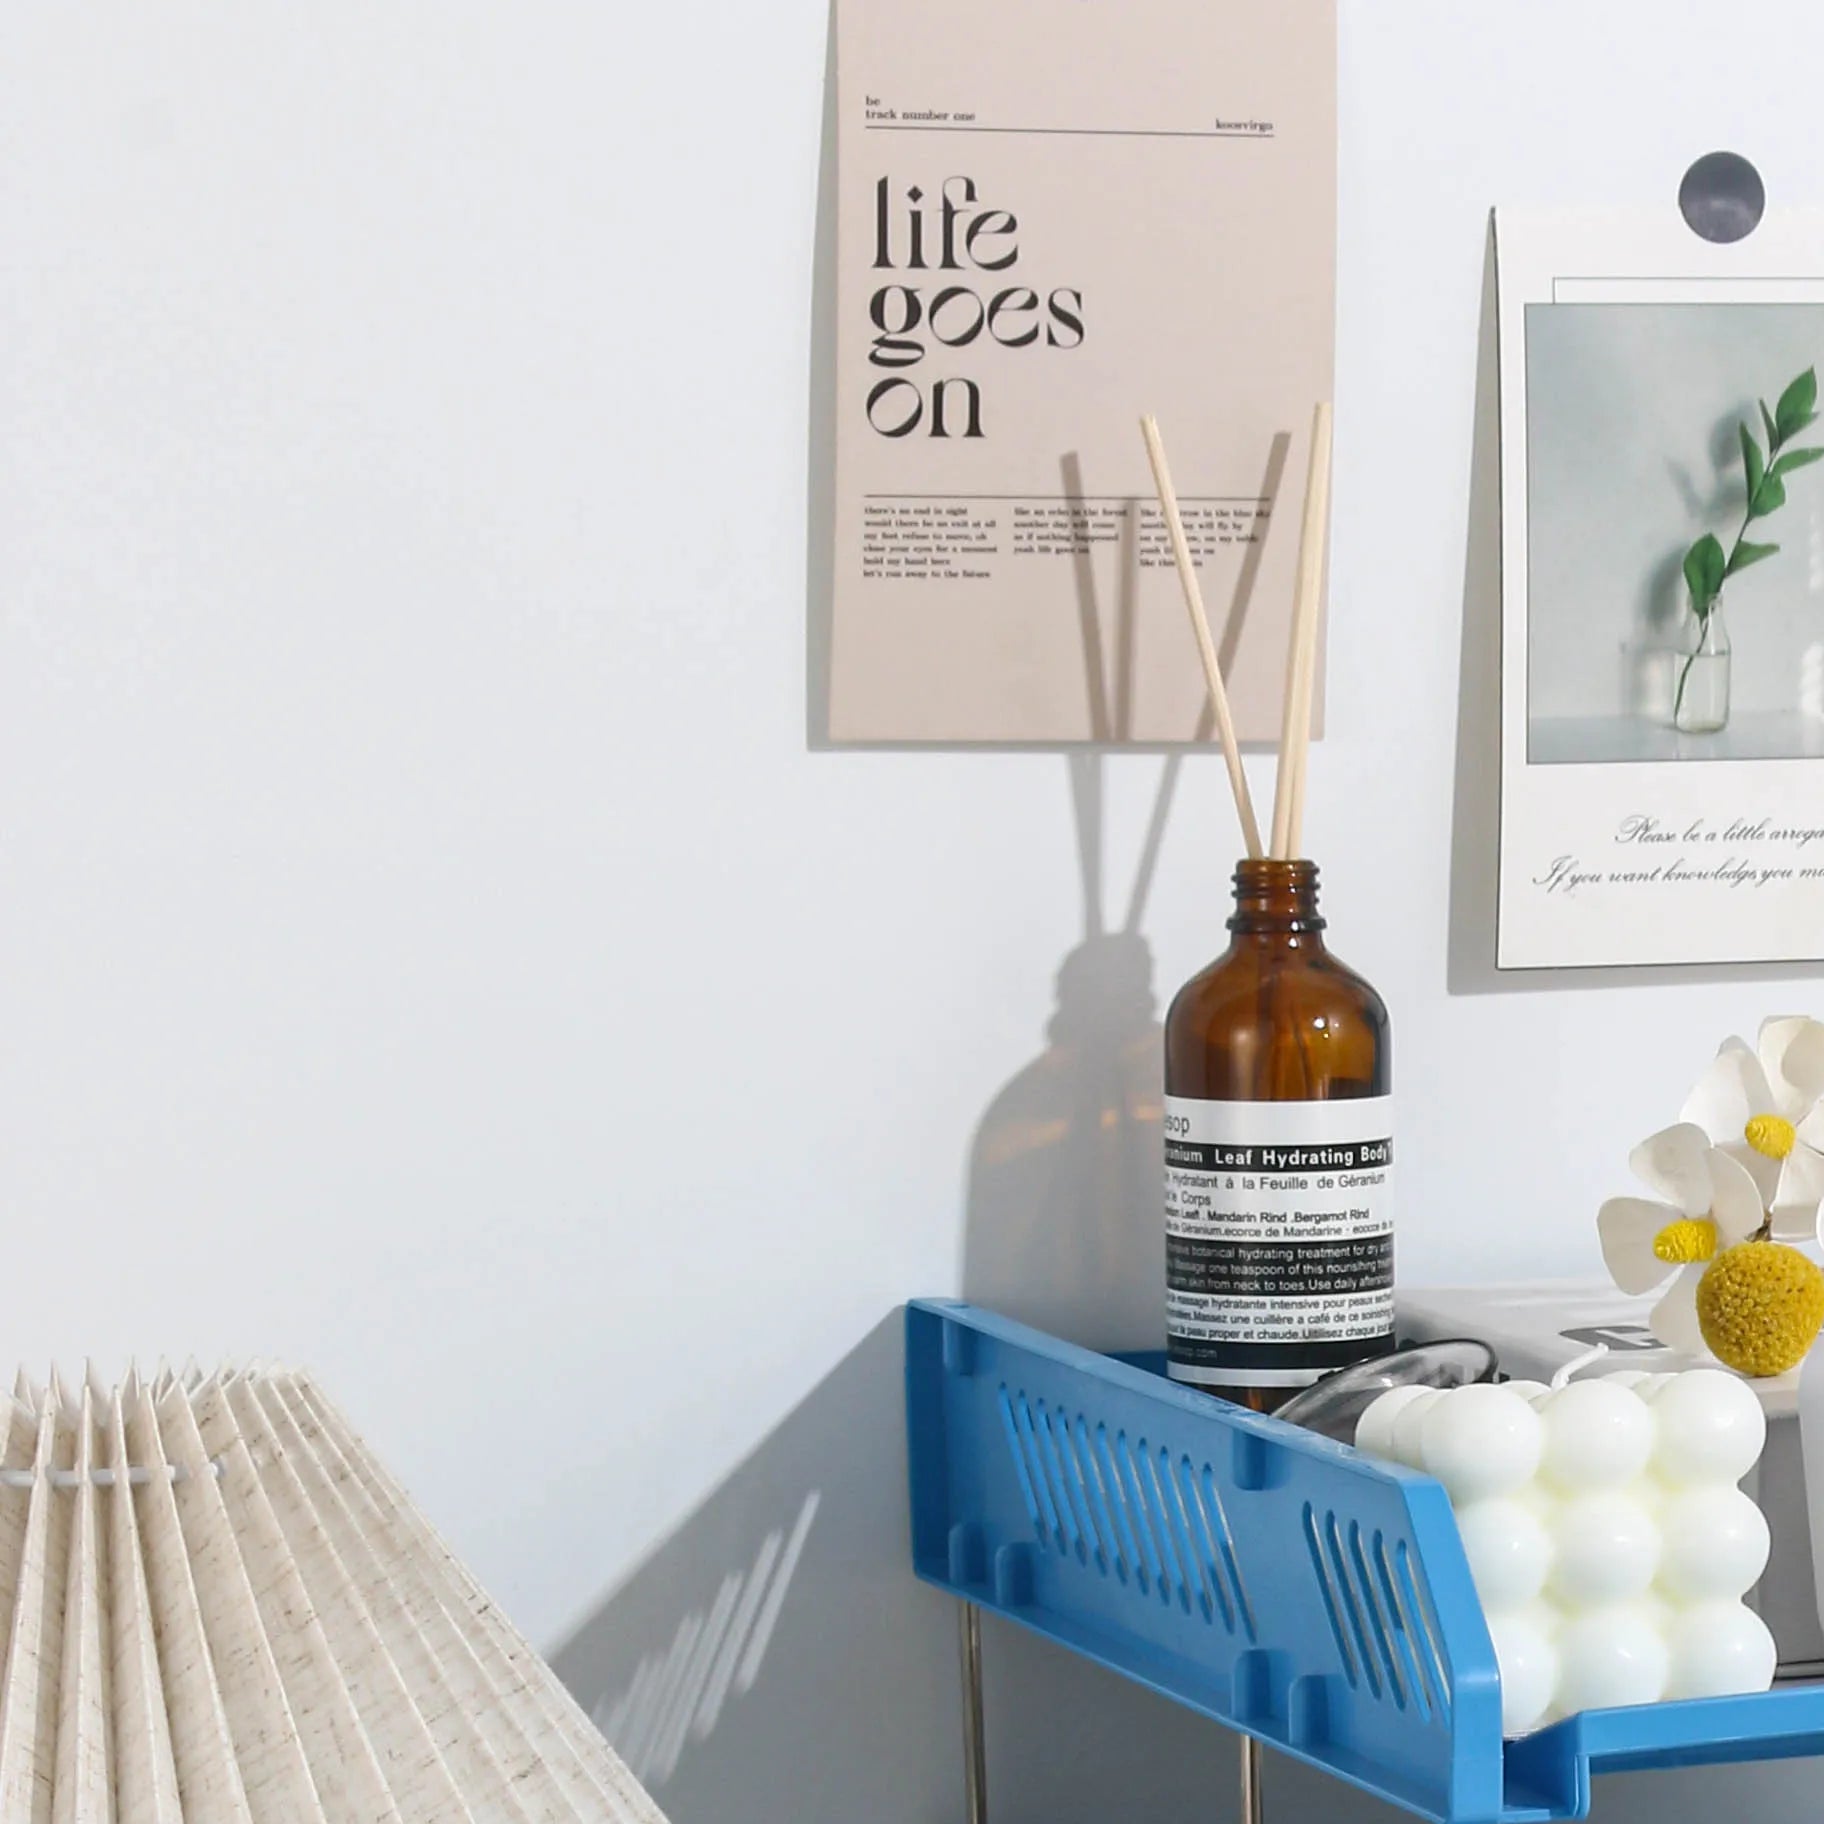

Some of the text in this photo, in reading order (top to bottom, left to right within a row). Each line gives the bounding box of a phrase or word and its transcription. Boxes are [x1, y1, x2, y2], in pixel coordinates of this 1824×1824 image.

[865, 95, 880, 106] be
[865, 109, 975, 122] track number one
[871, 174, 1019, 271] life
[868, 283, 1085, 367] goes
[866, 376, 986, 438] on
[1615, 814, 1676, 844] Please
[1682, 818, 1700, 841] be
[1705, 829, 1716, 841] a
[1723, 817, 1765, 841] little
[1569, 871, 1602, 893] you
[1609, 866, 1659, 883] want
[1760, 868, 1794, 889] you
[1215, 1148, 1253, 1165] Leaf
[1262, 1148, 1354, 1168] Hydrating
[1242, 1176, 1334, 1190] la Feuille de
[1181, 1191, 1211, 1207] Corps
[1208, 1210, 1256, 1222] Mandarin
[1260, 1211, 1288, 1223] Rind
[1350, 1208, 1370, 1219] Rind
[1283, 1225, 1342, 1237] Mandarine
[1238, 1246, 1294, 1262] hydrating
[1297, 1246, 1351, 1258] treatment
[1353, 1244, 1365, 1256] for
[1208, 1264, 1228, 1274] one
[1230, 1263, 1285, 1277] teaspoon
[1288, 1263, 1301, 1275] of
[1303, 1263, 1324, 1275] this
[1233, 1279, 1261, 1291] neck
[1264, 1280, 1276, 1291] to
[1270, 1298, 1320, 1309] intensive
[1230, 1315, 1250, 1324] une
[1243, 1329, 1254, 1340] et
